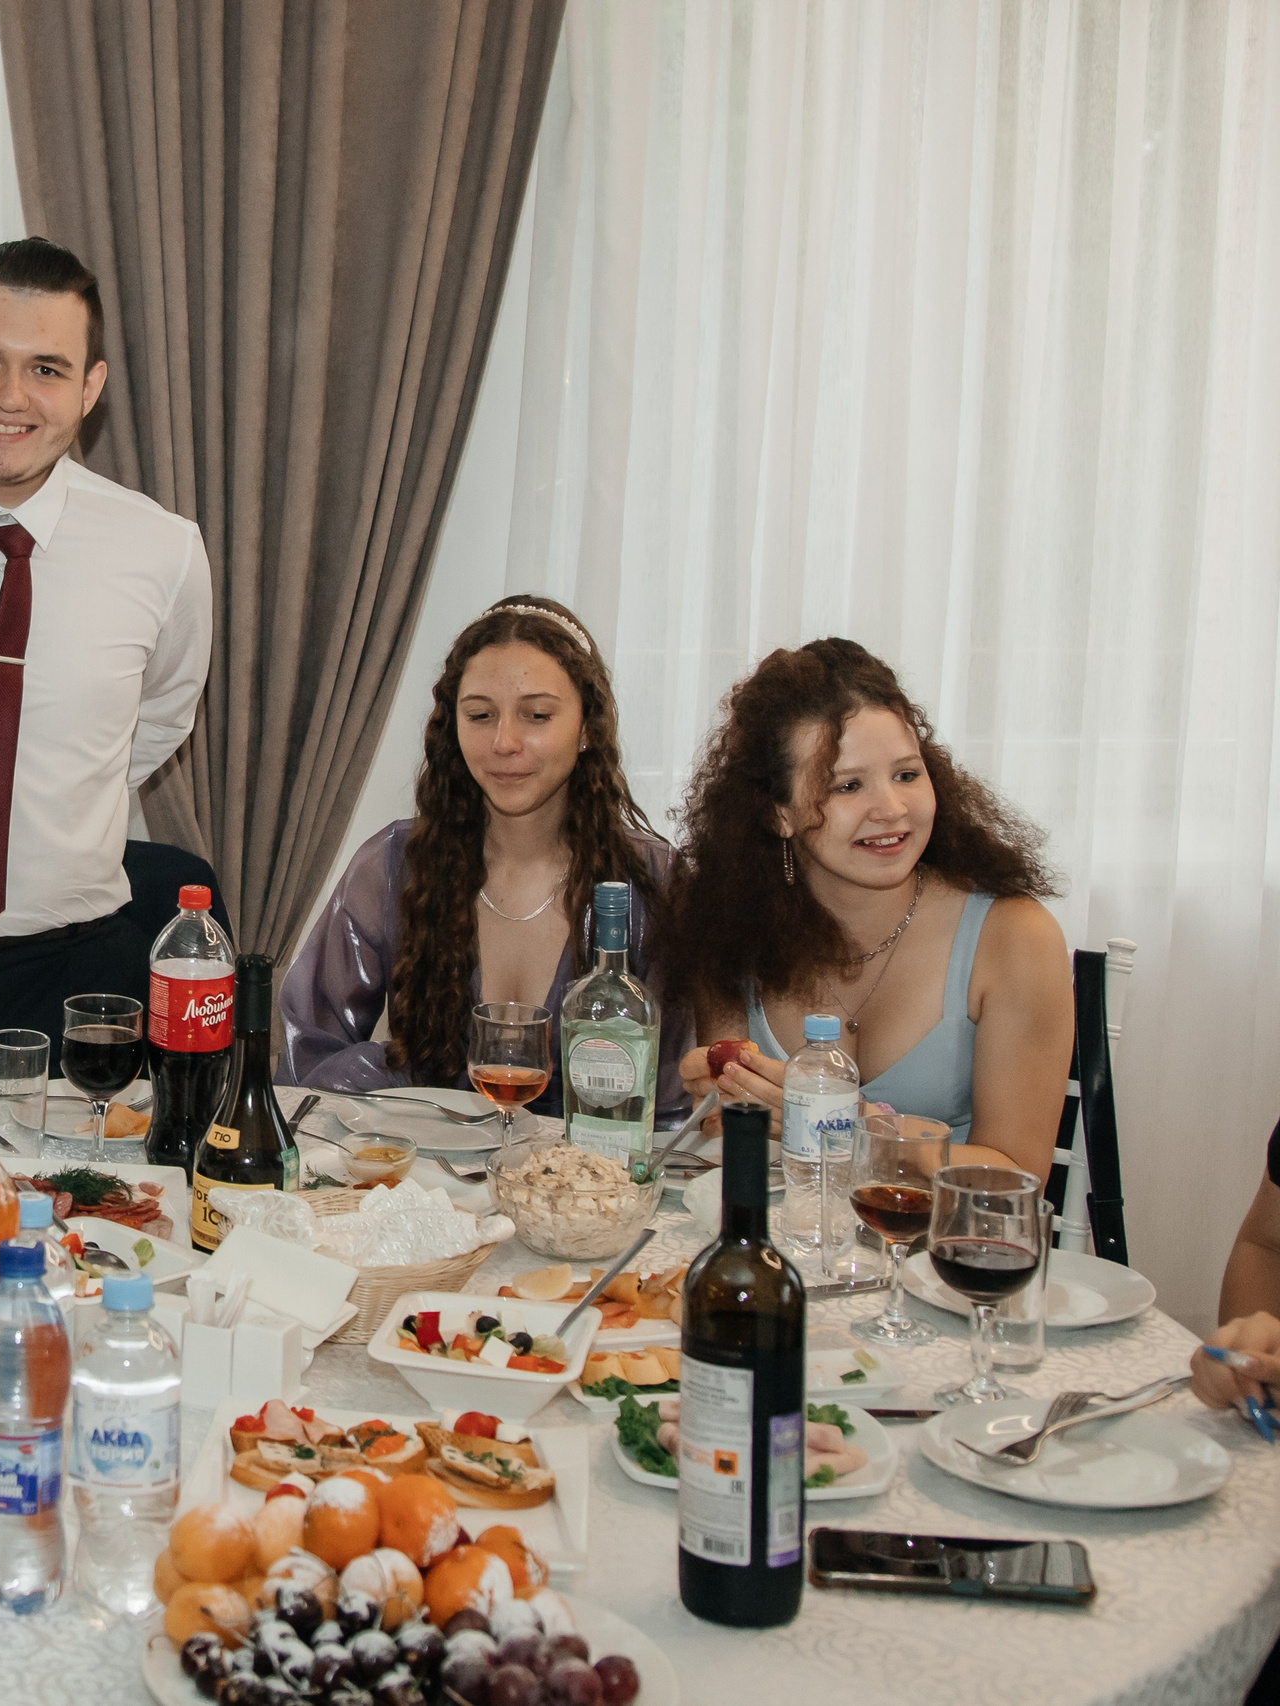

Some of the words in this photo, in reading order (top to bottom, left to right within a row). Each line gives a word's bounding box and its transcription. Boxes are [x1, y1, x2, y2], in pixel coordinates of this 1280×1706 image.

[201, 1011, 227, 1028] кола
[815, 1118, 852, 1131] АКВА
[90, 1428, 144, 1447] АКВА
